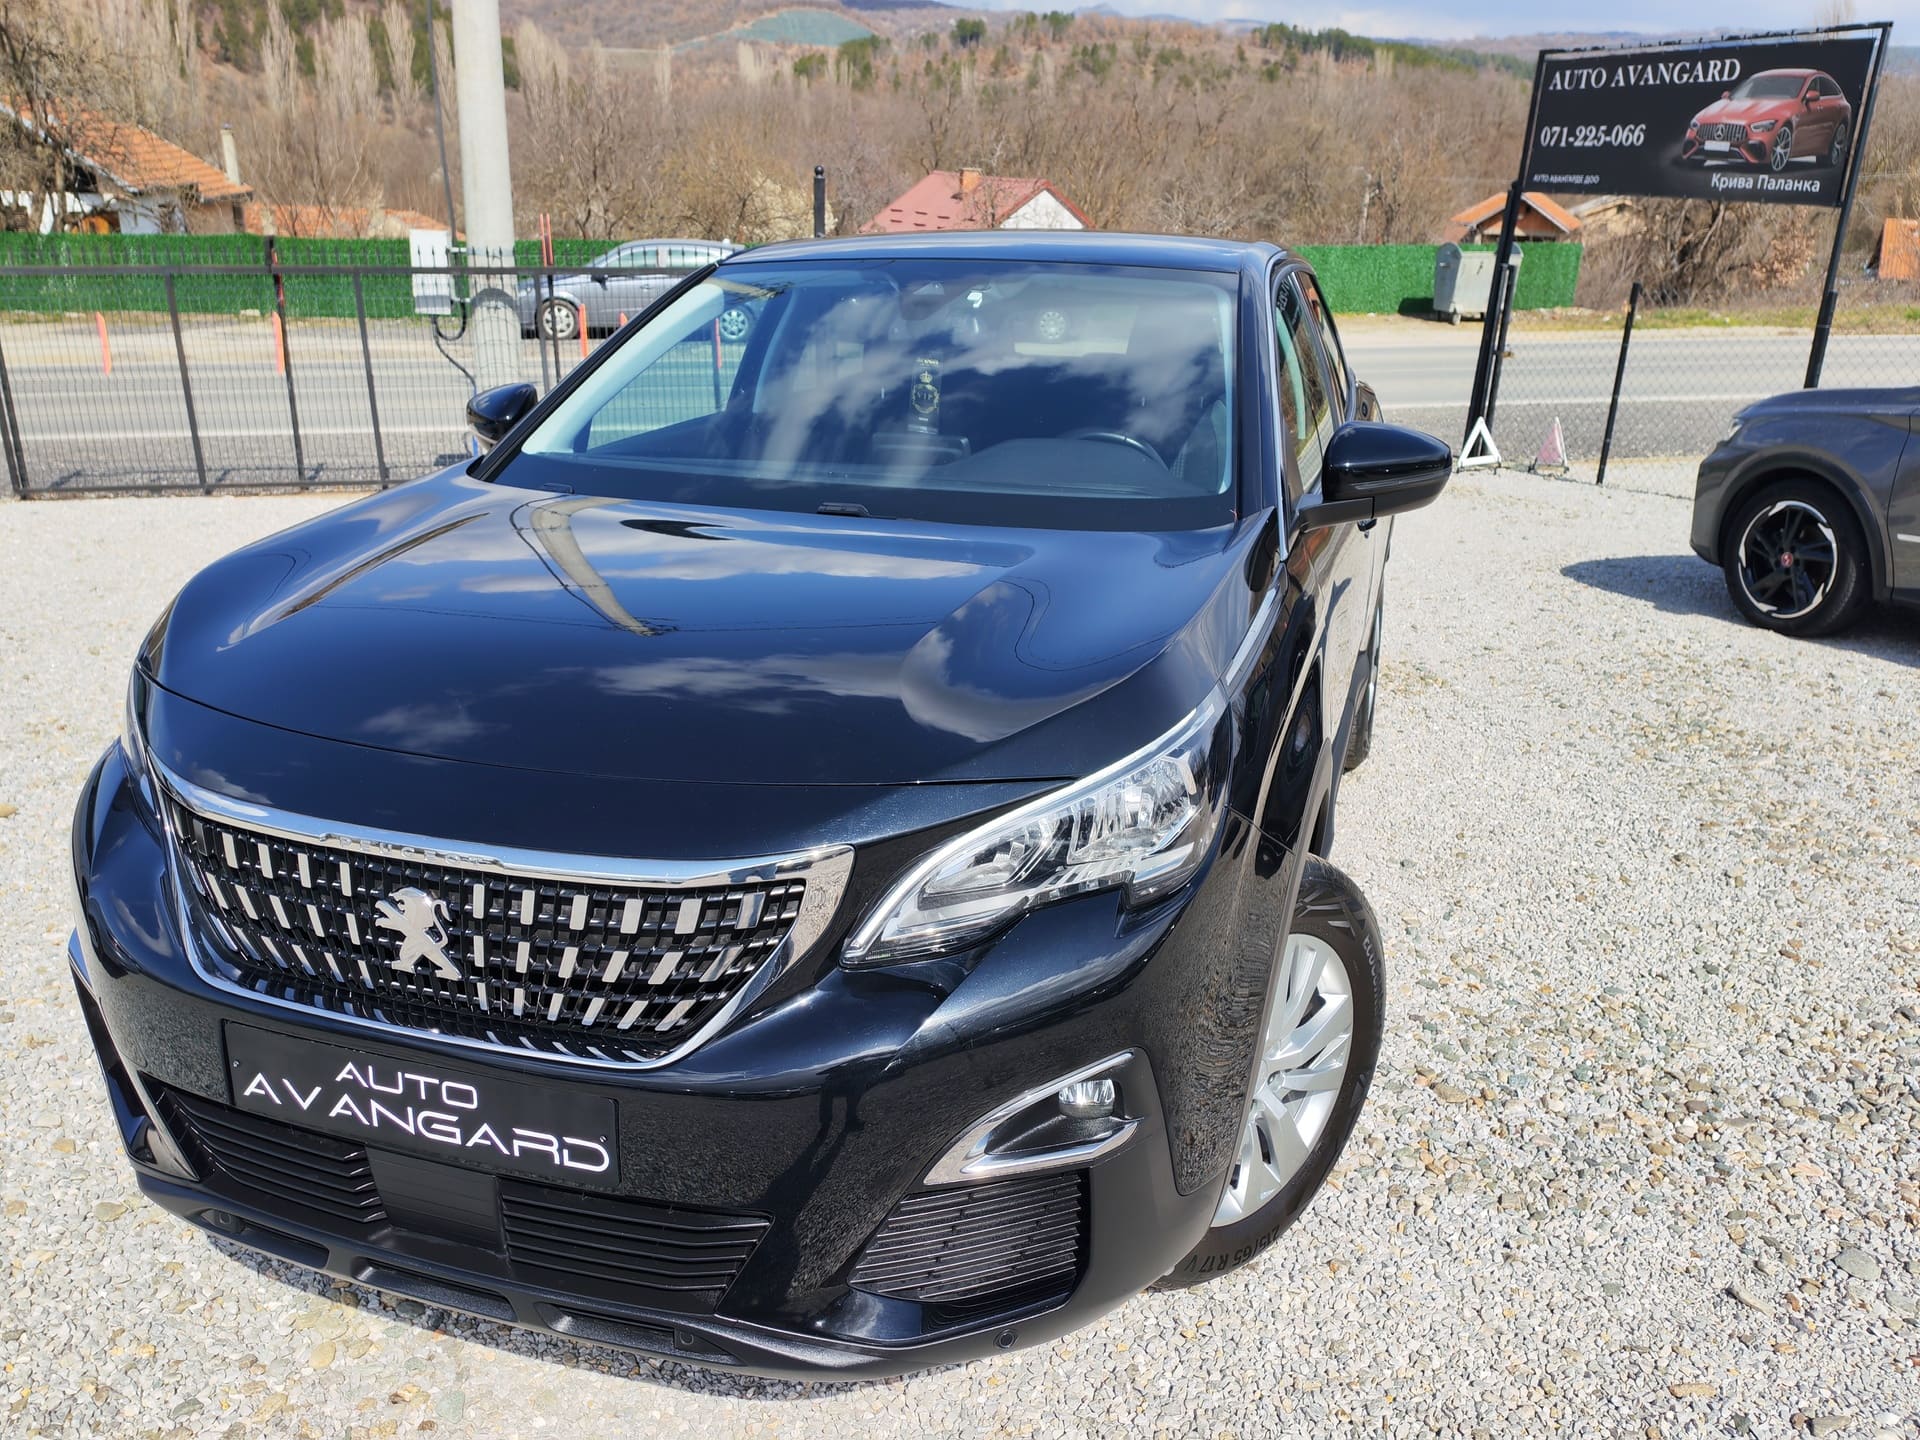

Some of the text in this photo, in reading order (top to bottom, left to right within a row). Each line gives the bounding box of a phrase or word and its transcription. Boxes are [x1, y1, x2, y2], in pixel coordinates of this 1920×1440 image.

[1549, 58, 1741, 91] AUTO AVANGARD
[1540, 124, 1646, 148] 071-225-066
[1711, 172, 1821, 193] Крива Паланка
[336, 1061, 479, 1110] AUTO
[243, 1072, 611, 1173] AVANGARD
